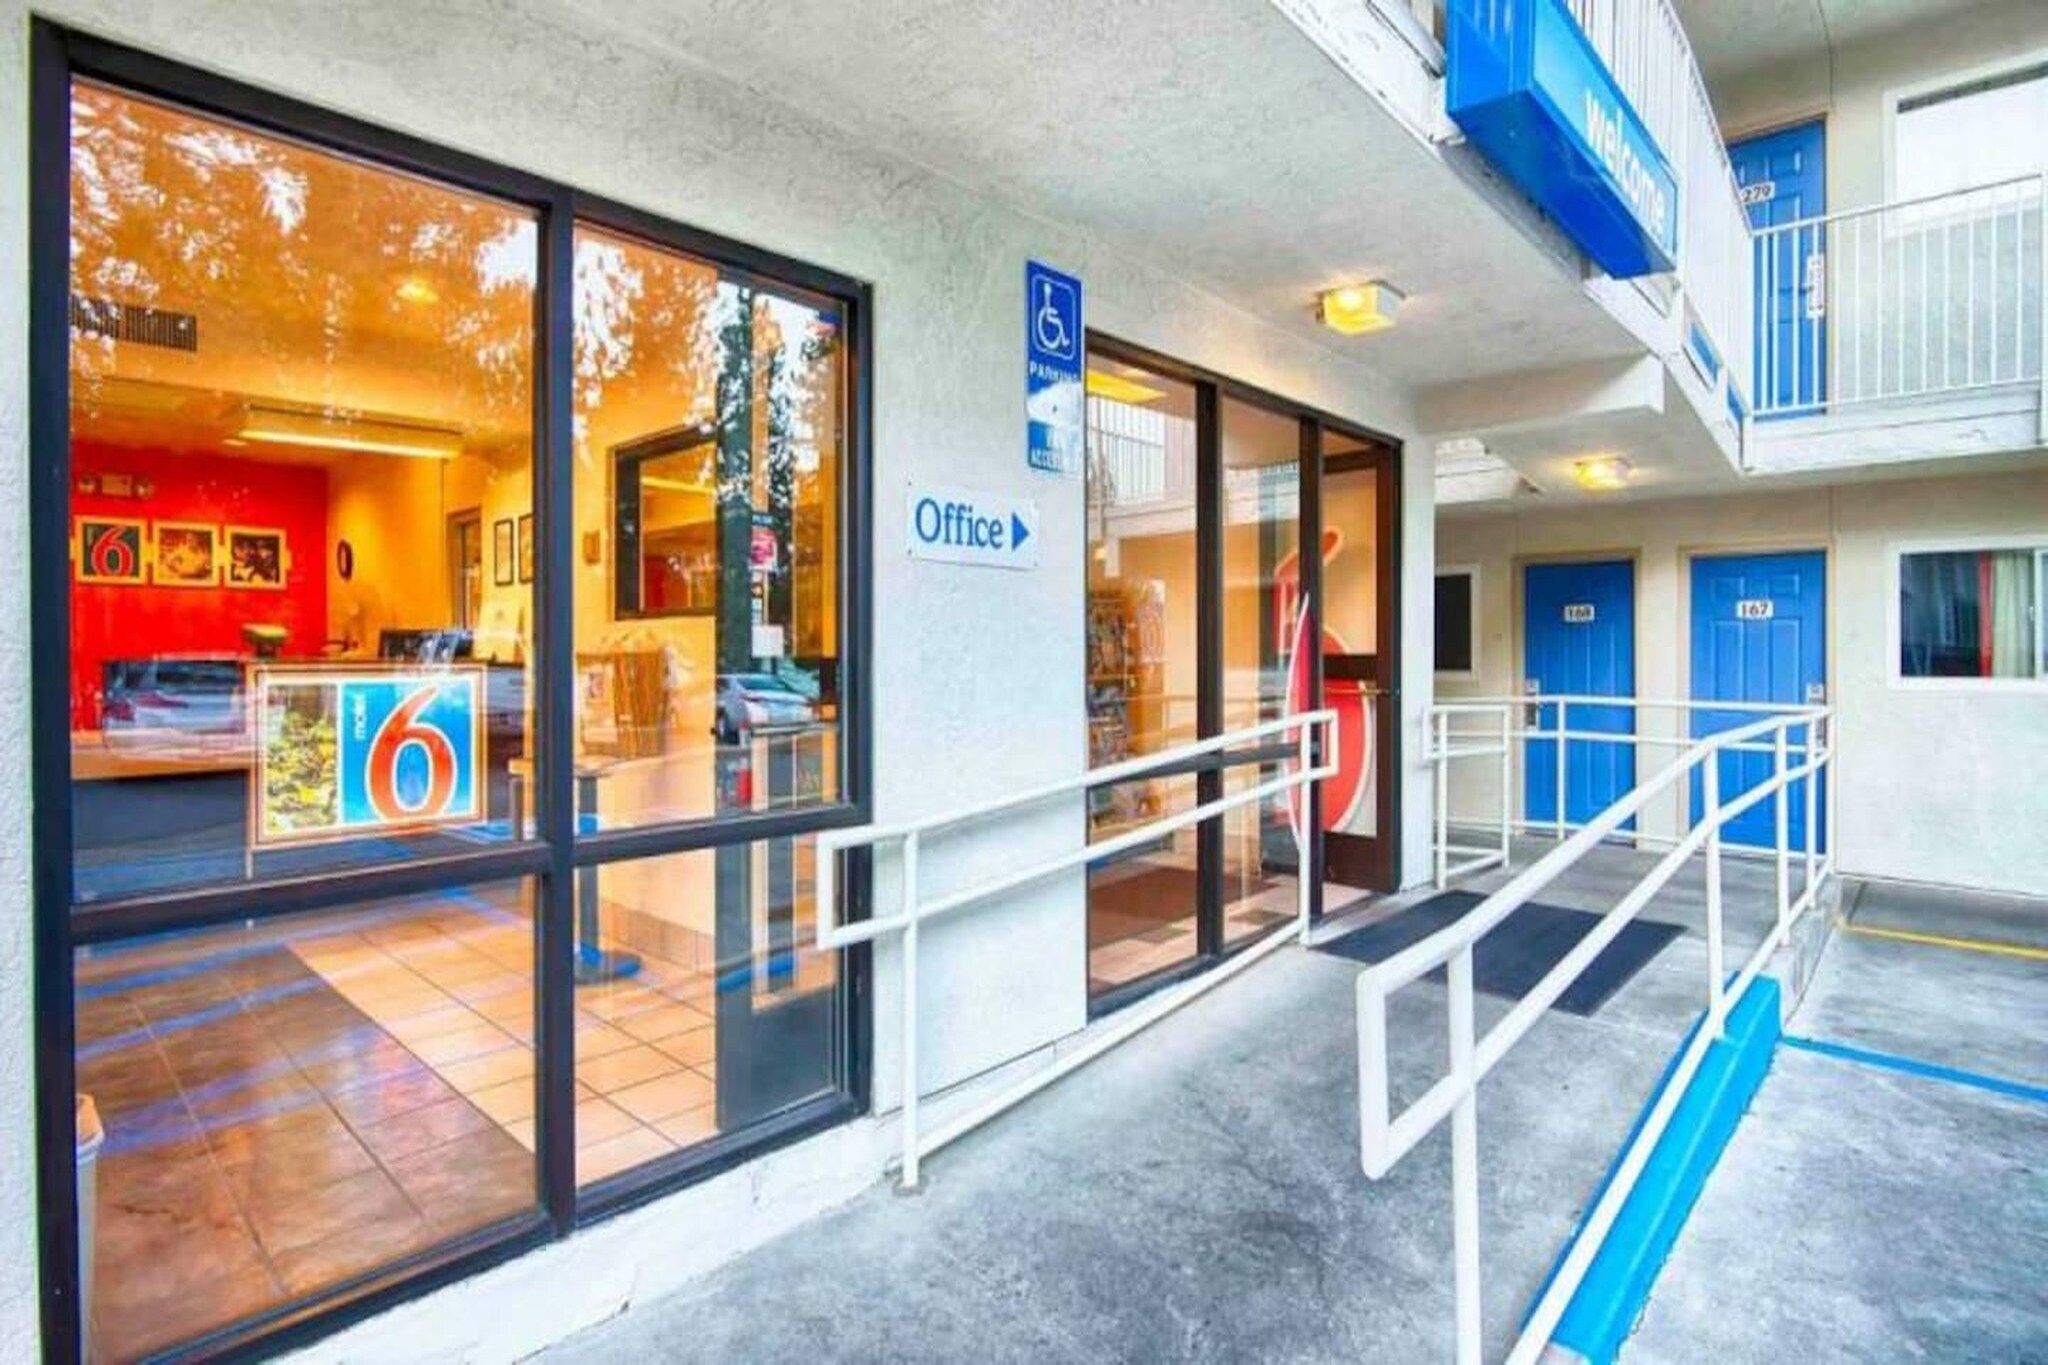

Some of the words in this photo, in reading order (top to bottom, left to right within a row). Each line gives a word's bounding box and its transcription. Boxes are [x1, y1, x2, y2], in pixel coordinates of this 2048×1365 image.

[1585, 88, 1665, 240] welcome
[915, 497, 1004, 550] Office
[91, 525, 134, 577] 6
[1741, 602, 1769, 616] 167
[364, 684, 458, 822] 6
